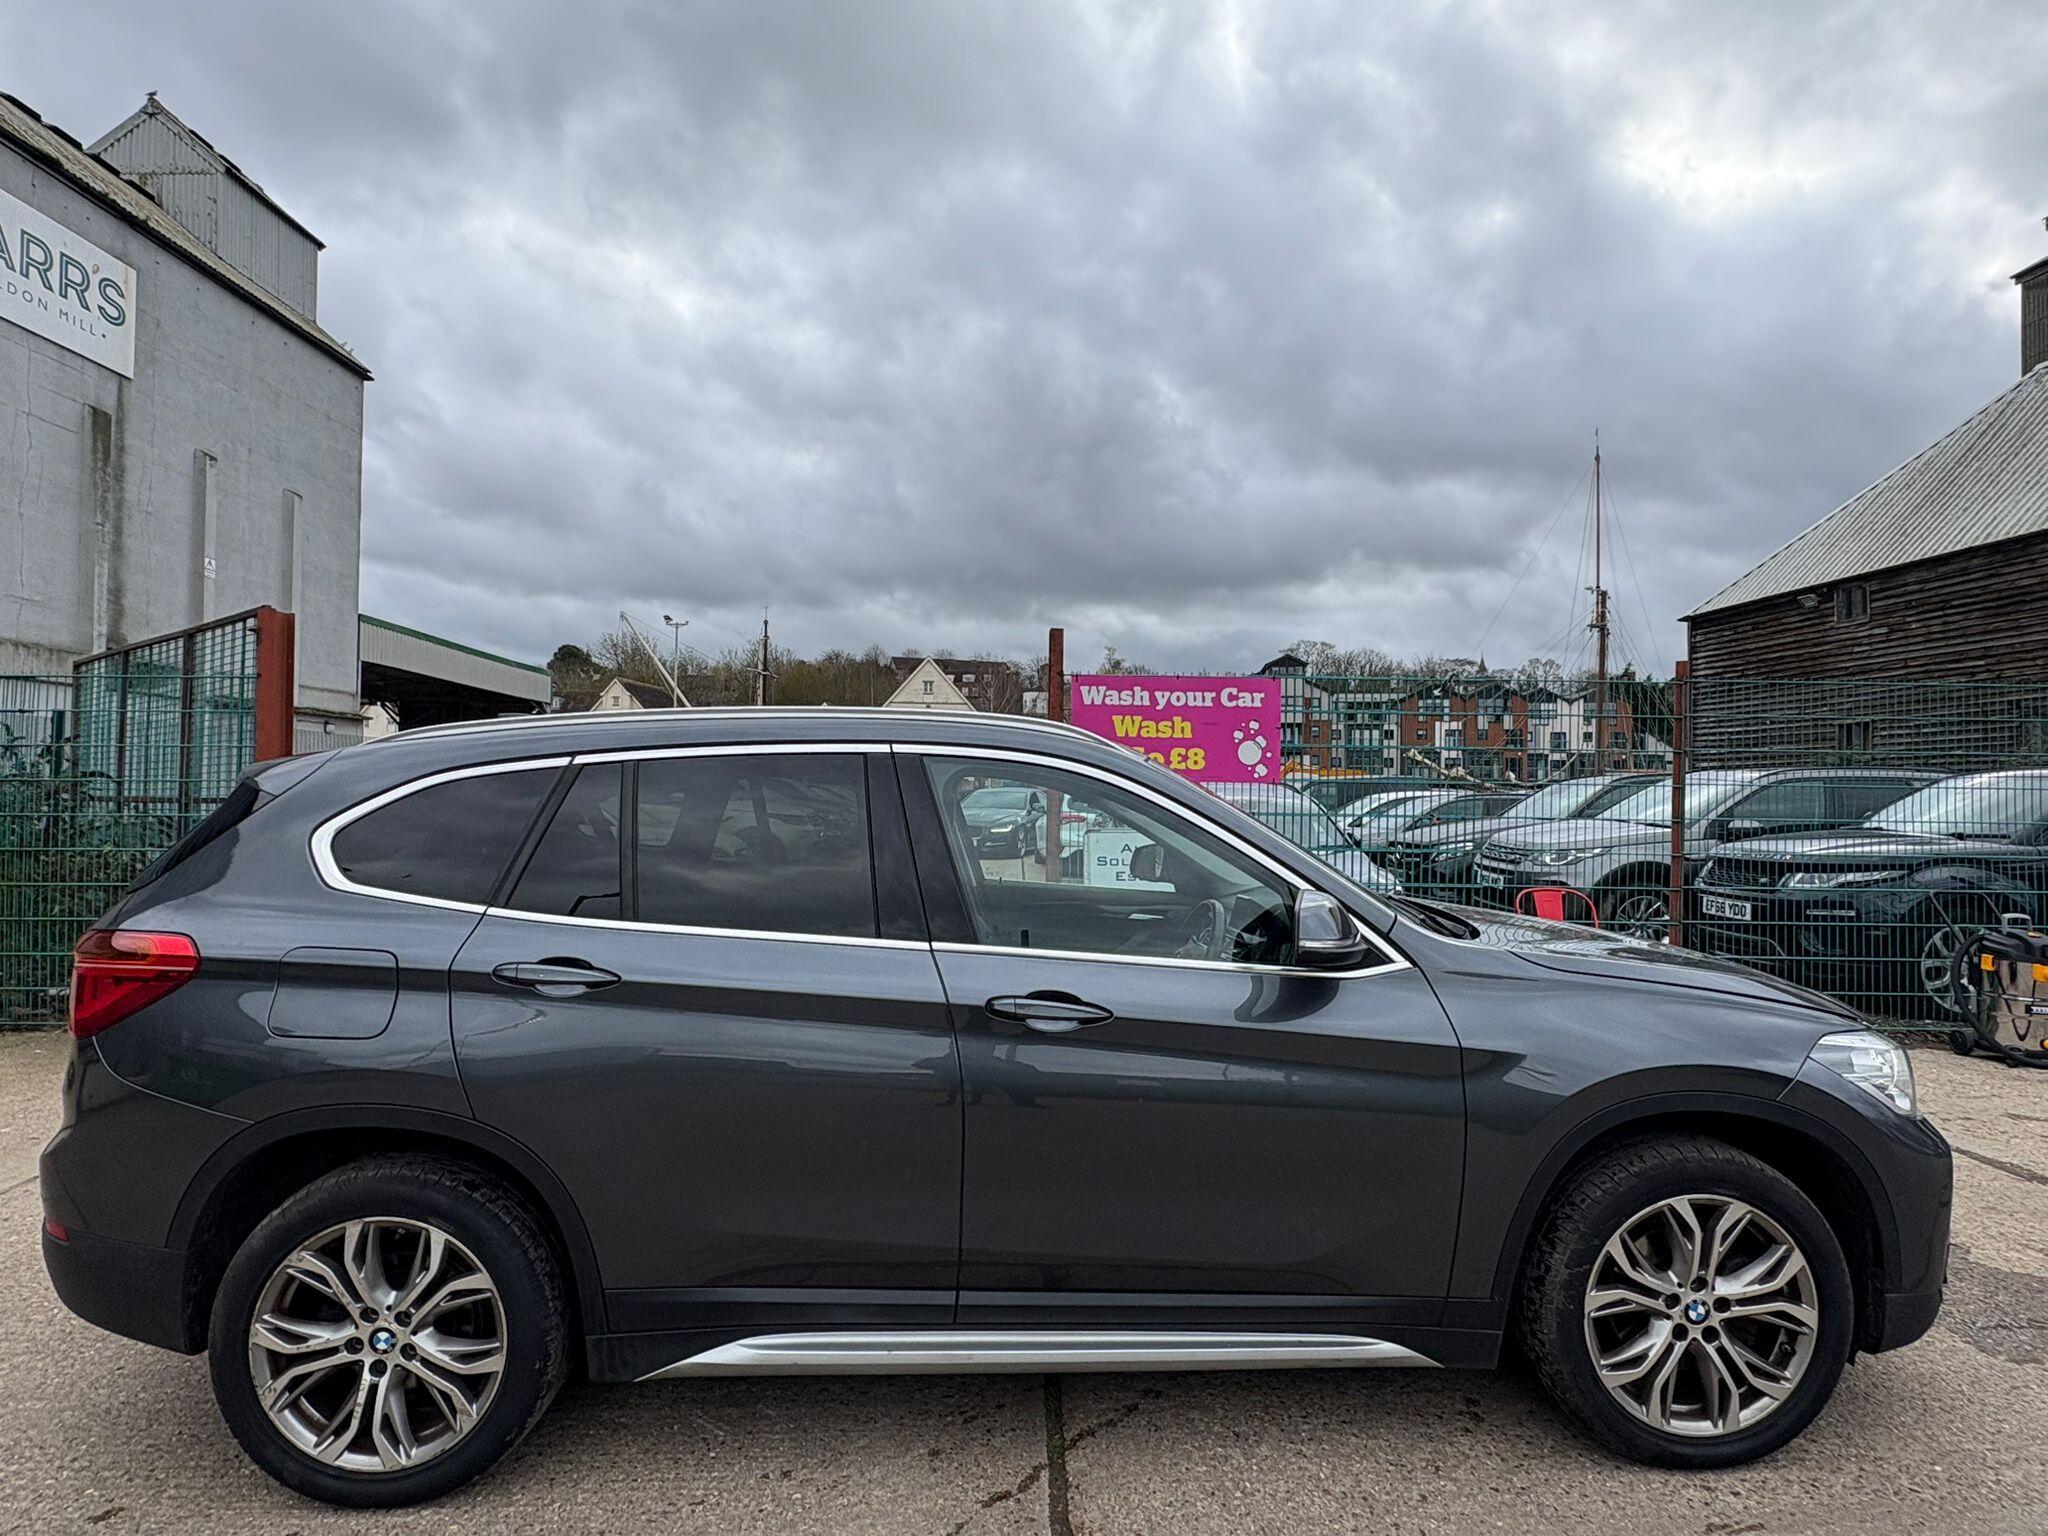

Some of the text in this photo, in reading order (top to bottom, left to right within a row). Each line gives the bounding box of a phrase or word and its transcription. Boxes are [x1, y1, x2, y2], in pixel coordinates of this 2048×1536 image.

[0, 281, 48, 311] DON
[1080, 685, 1265, 710] Wash your Car
[1112, 715, 1192, 738] Wash
[1169, 747, 1206, 770] £8
